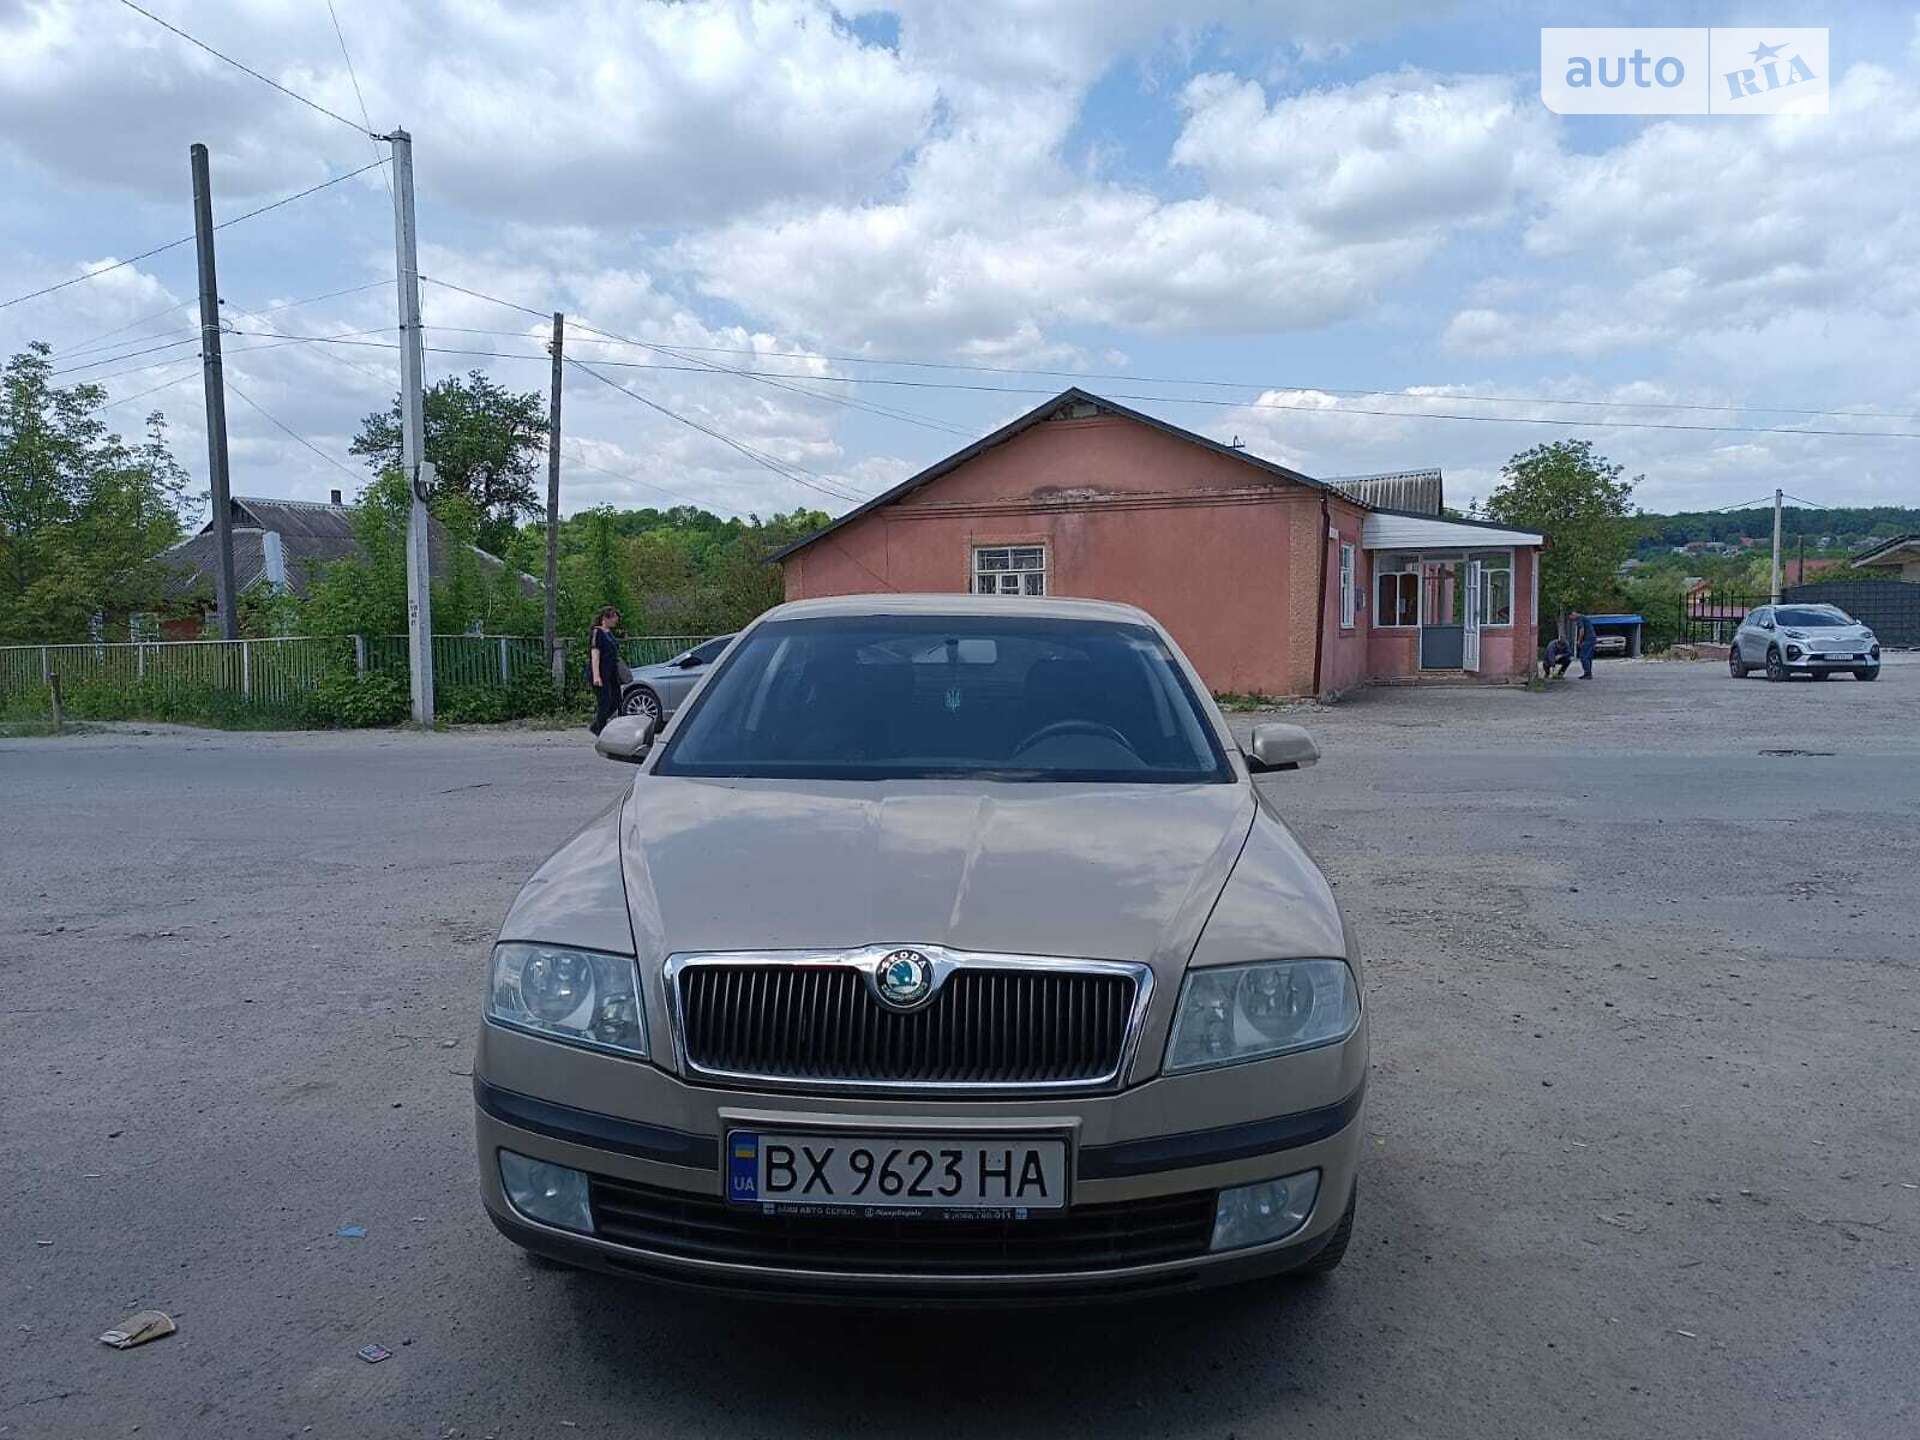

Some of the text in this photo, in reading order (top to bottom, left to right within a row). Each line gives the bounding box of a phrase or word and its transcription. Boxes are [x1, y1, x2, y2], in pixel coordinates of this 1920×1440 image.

[734, 1178, 755, 1192] UA
[766, 1145, 1048, 1198] BX 9623 HA
